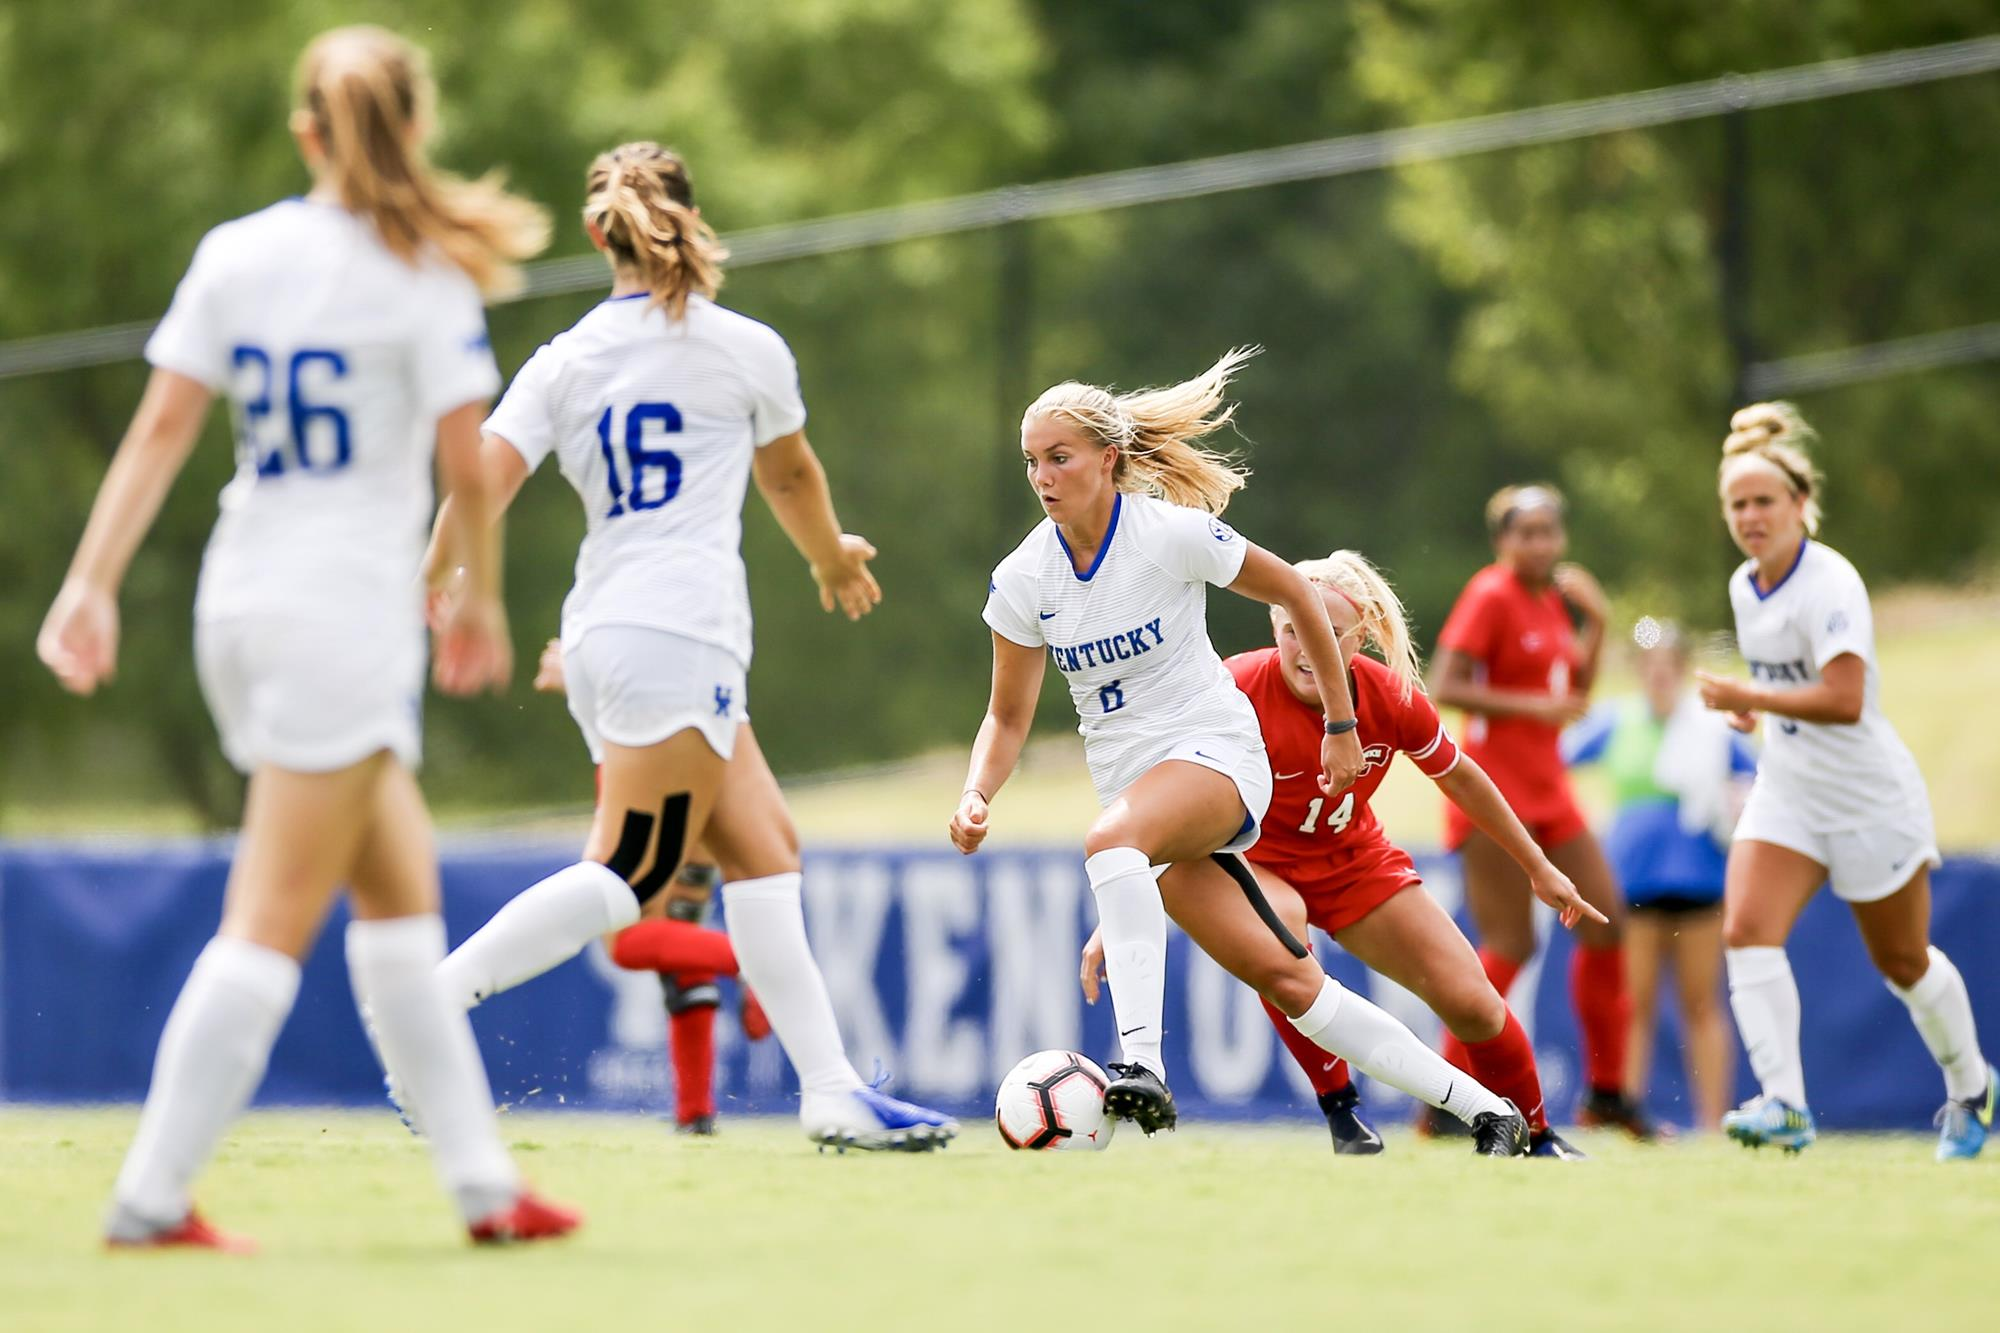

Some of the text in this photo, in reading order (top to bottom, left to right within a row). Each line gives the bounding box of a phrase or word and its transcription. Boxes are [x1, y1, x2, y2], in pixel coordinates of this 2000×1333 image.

[231, 345, 351, 477] 26
[597, 403, 683, 518] 16
[1299, 792, 1354, 834] 14
